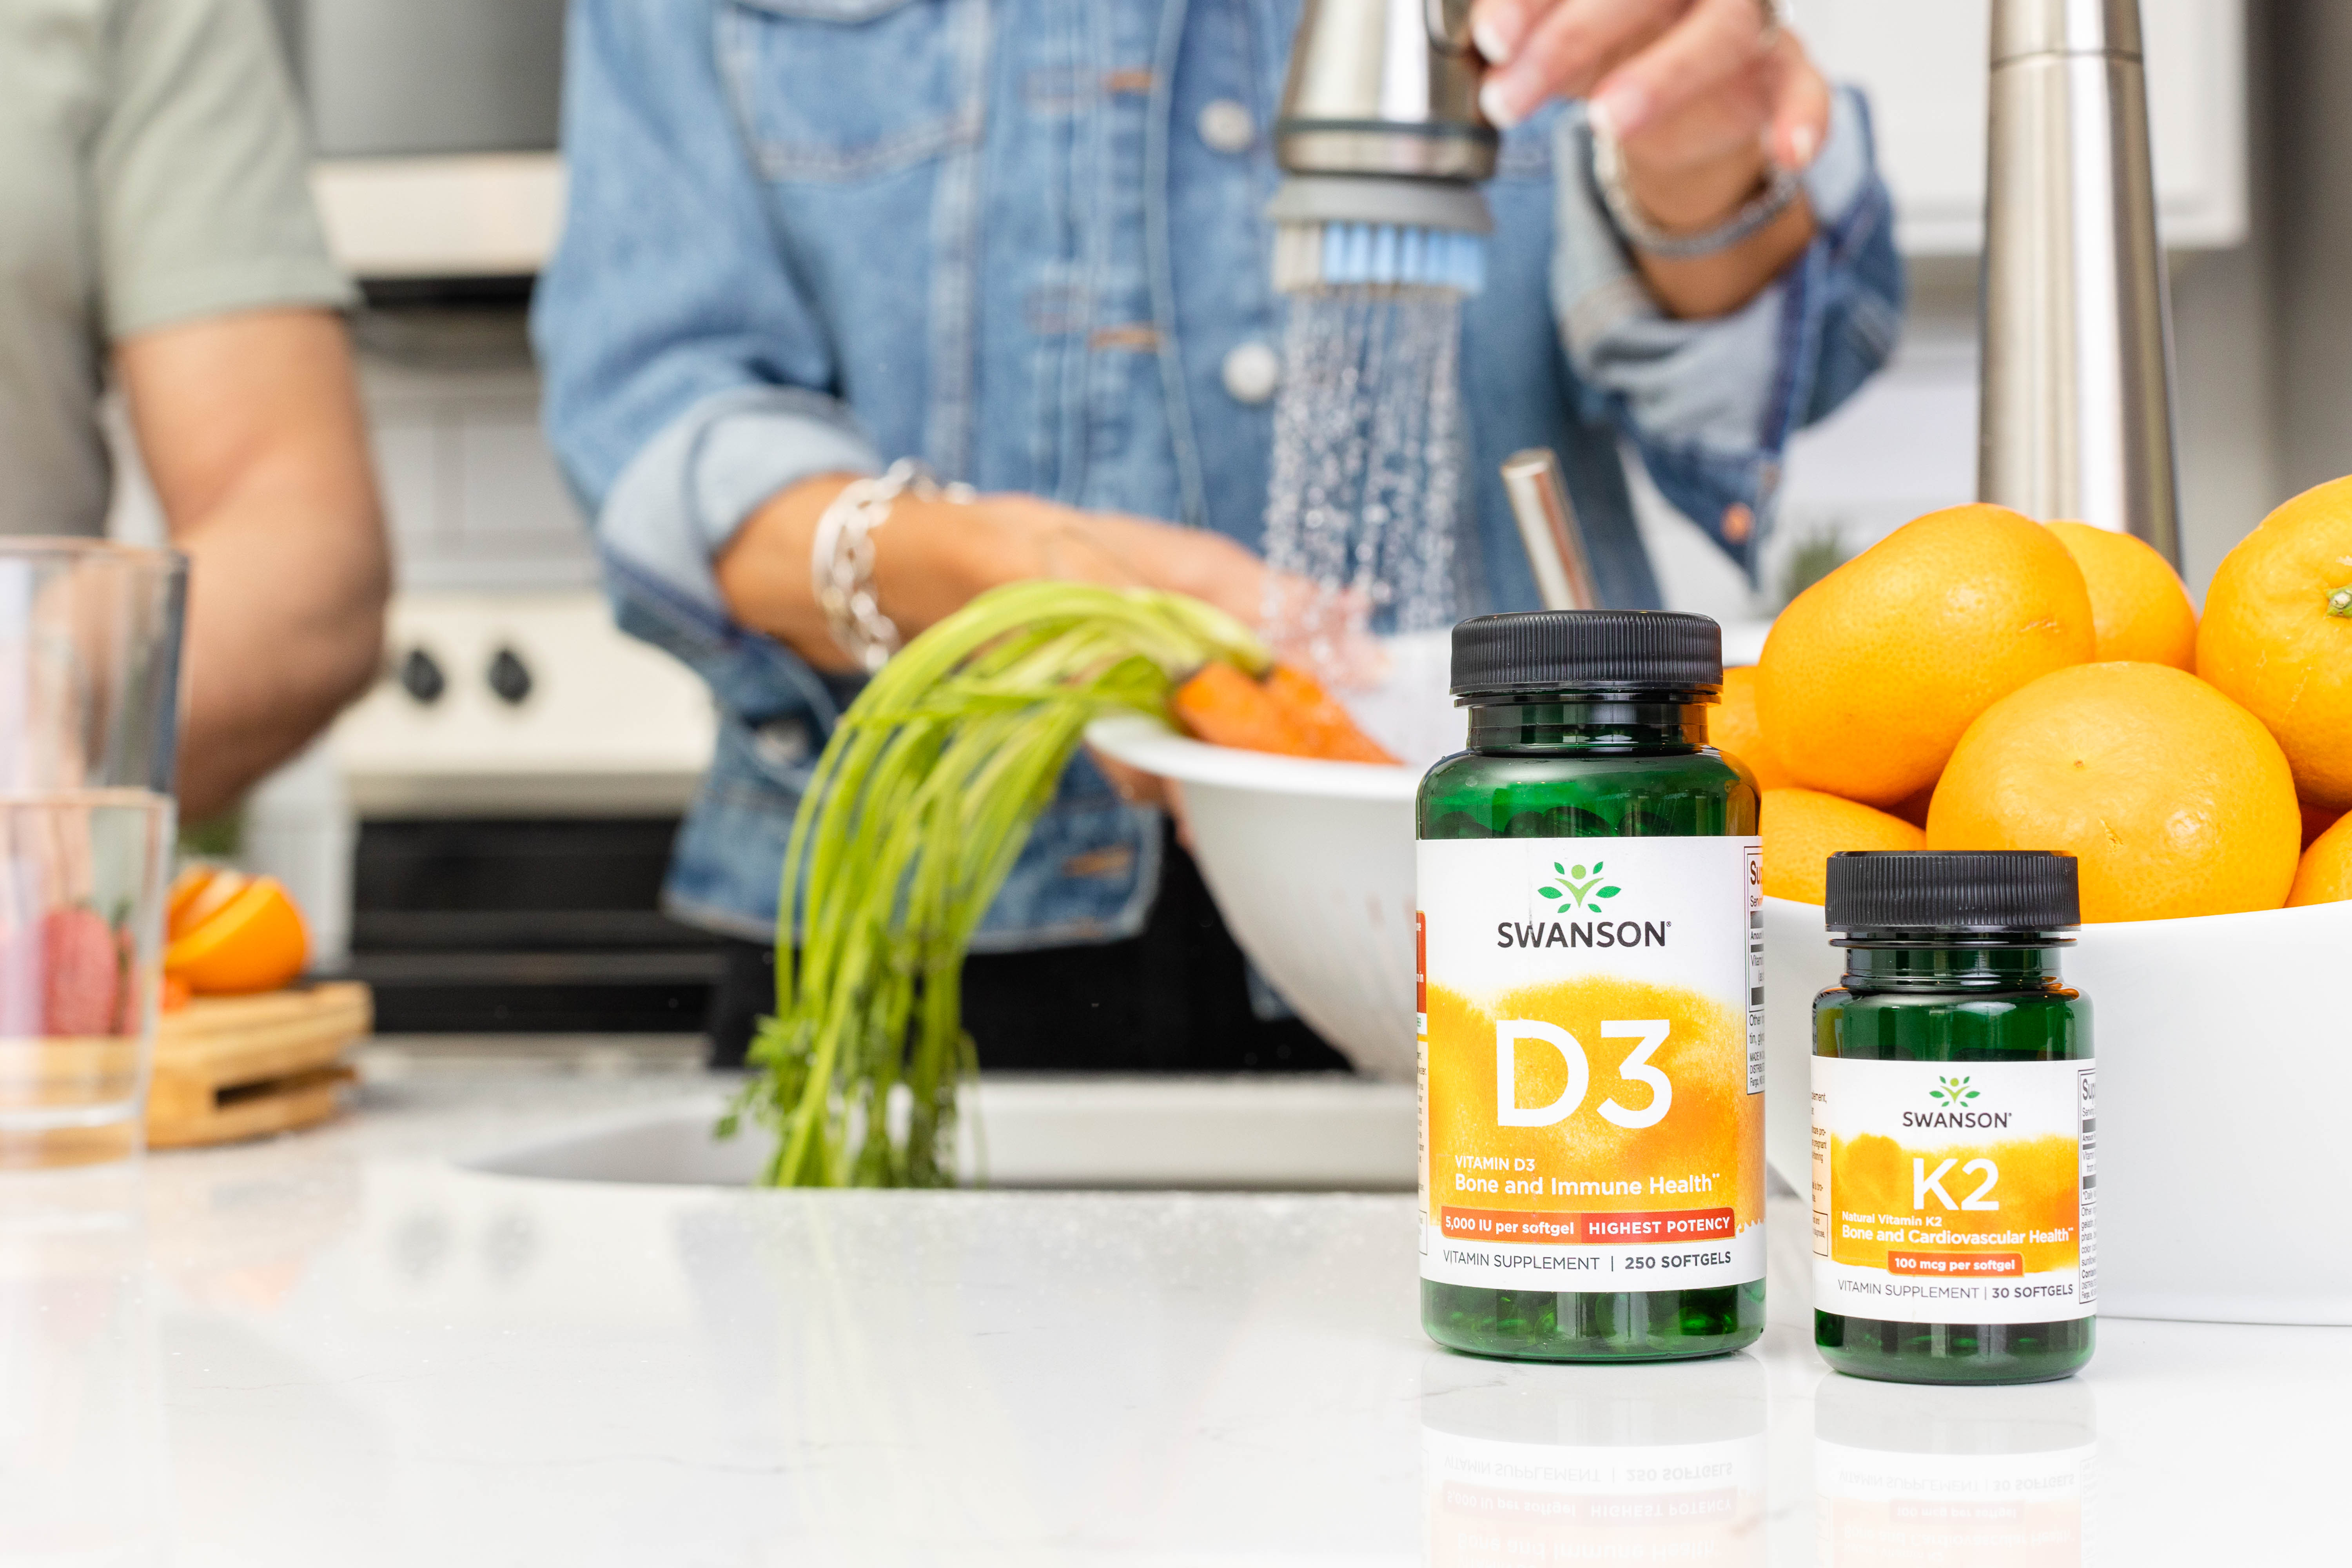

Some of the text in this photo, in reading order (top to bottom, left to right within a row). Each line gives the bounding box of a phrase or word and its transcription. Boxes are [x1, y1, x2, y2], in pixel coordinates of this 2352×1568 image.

[1496, 1018, 1673, 1129] D3
[1455, 1155, 1535, 1172] VITAMIN D3
[1455, 1173, 1499, 1193] Bone
[1504, 1176, 1543, 1195] and
[1551, 1177, 1642, 1195] Immune
[1913, 1158, 1999, 1210] K2
[1445, 1216, 1574, 1237] 5,000 IU per softgel
[1589, 1216, 1730, 1234] HIGHEST POTENCY
[1842, 1211, 1942, 1227] Natural Vitamin K2
[1842, 1224, 1873, 1240] Bone
[1876, 1228, 1904, 1242] and
[1908, 1229, 2026, 1245] Cardiovascular
[1443, 1250, 1489, 1266] VITAMIN
[1494, 1255, 1600, 1270] SUPPLEMENT
[1625, 1256, 1655, 1269] 250
[1661, 1251, 1731, 1268] SOFTGELS
[1895, 1258, 2015, 1272] 100 mcg per softgel
[1838, 1279, 1881, 1294] VITAMIN
[1885, 1285, 1979, 1298] SUPPLEMENT
[1992, 1288, 2009, 1298] 30
[2014, 1284, 2073, 1298] SOFTGELS
